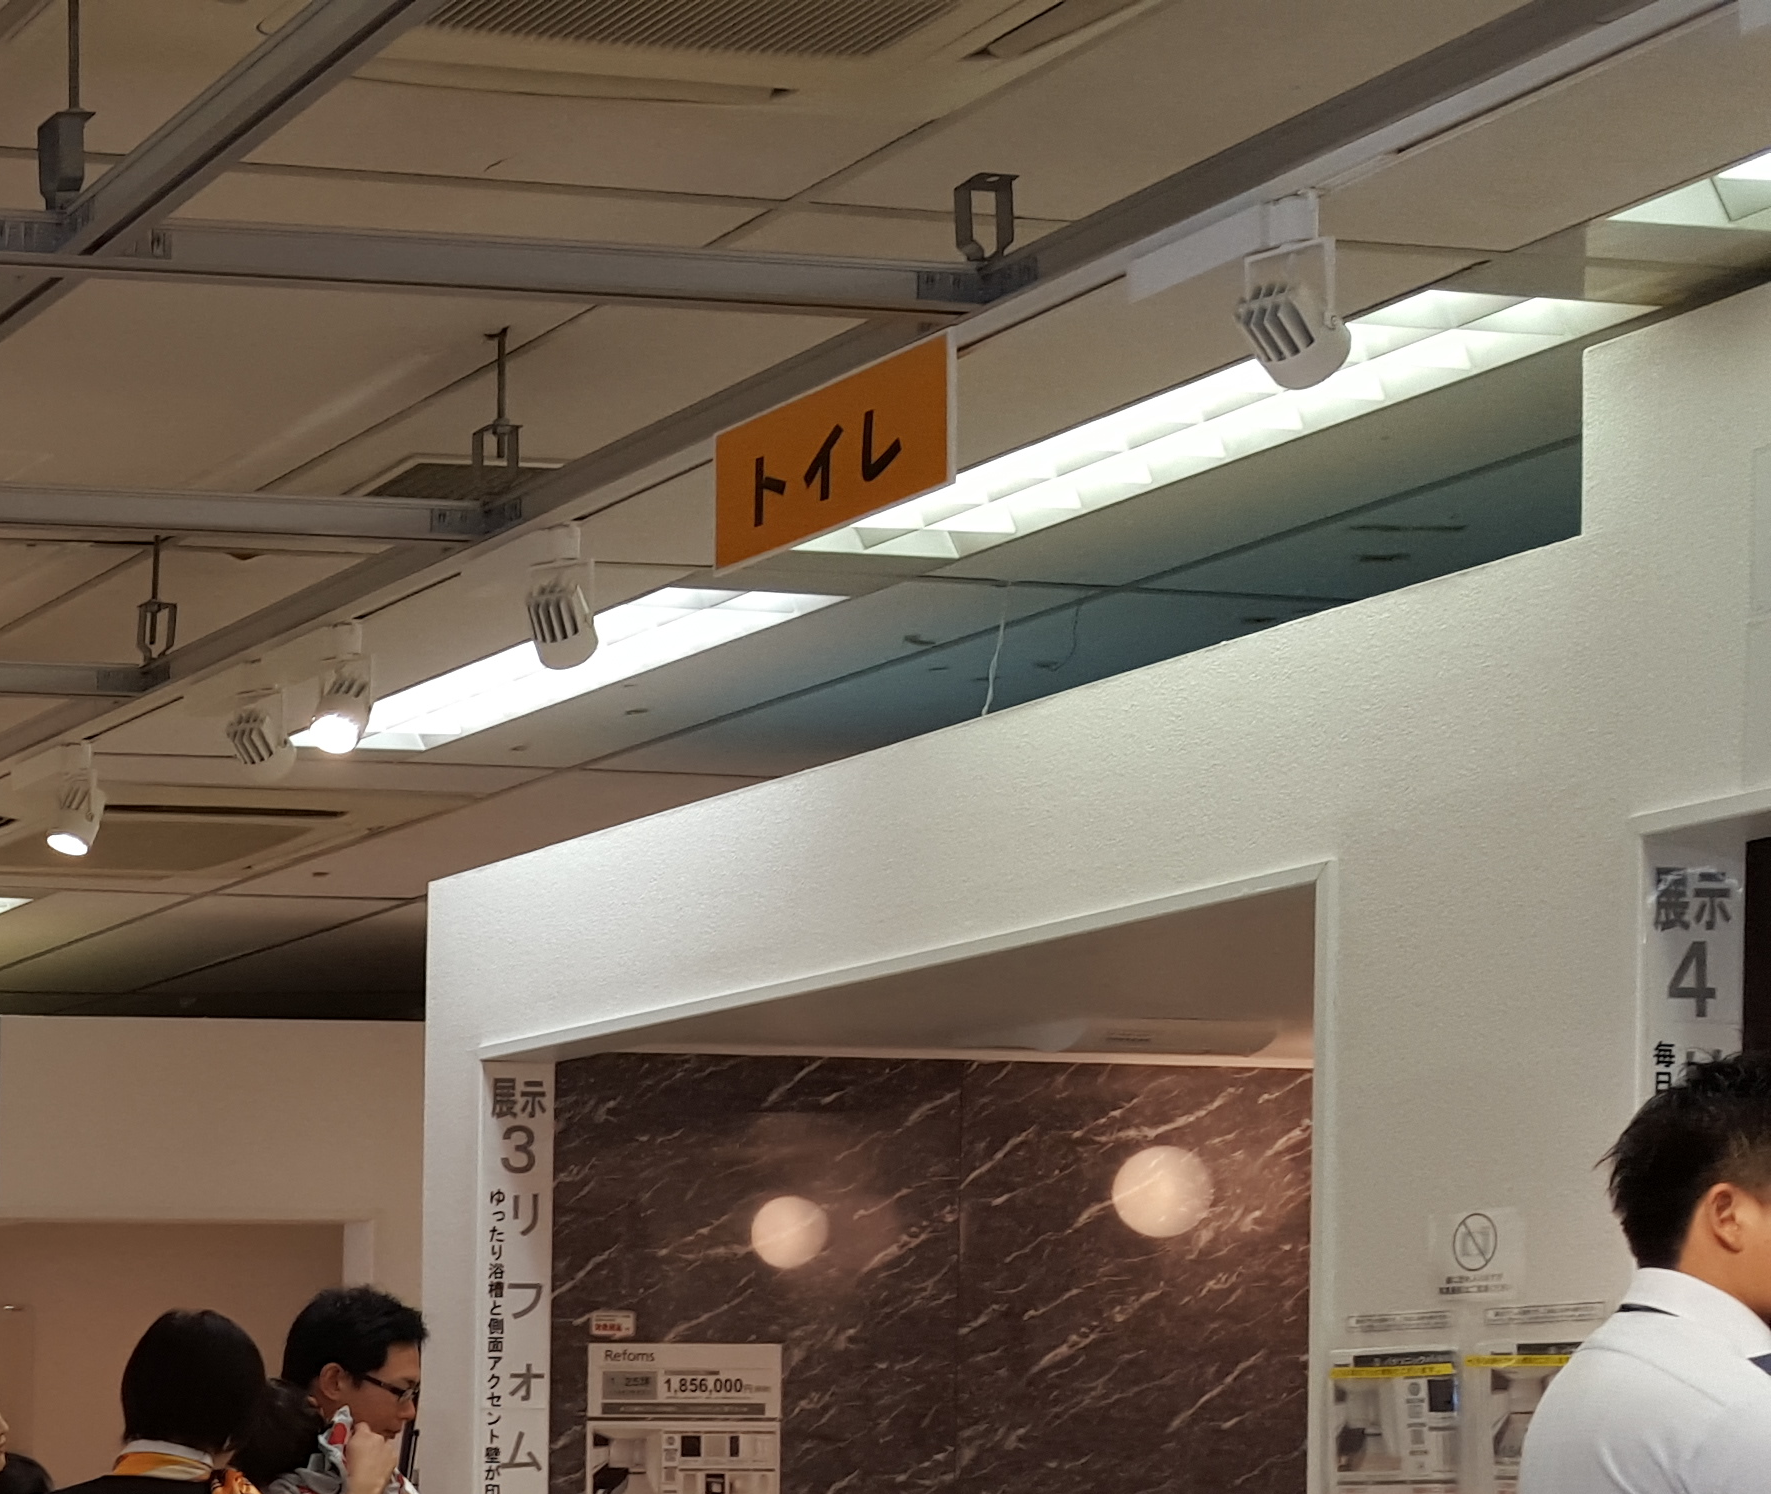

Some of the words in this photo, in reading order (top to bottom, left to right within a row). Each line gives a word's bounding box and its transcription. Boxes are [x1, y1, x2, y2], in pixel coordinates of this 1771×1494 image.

[754, 409, 902, 527] トイレ
[1653, 867, 1732, 932] 展示
[1668, 941, 1717, 1018] 4
[491, 1077, 547, 1120] 展示
[501, 1125, 536, 1174] 3
[604, 1349, 655, 1363] Refoms
